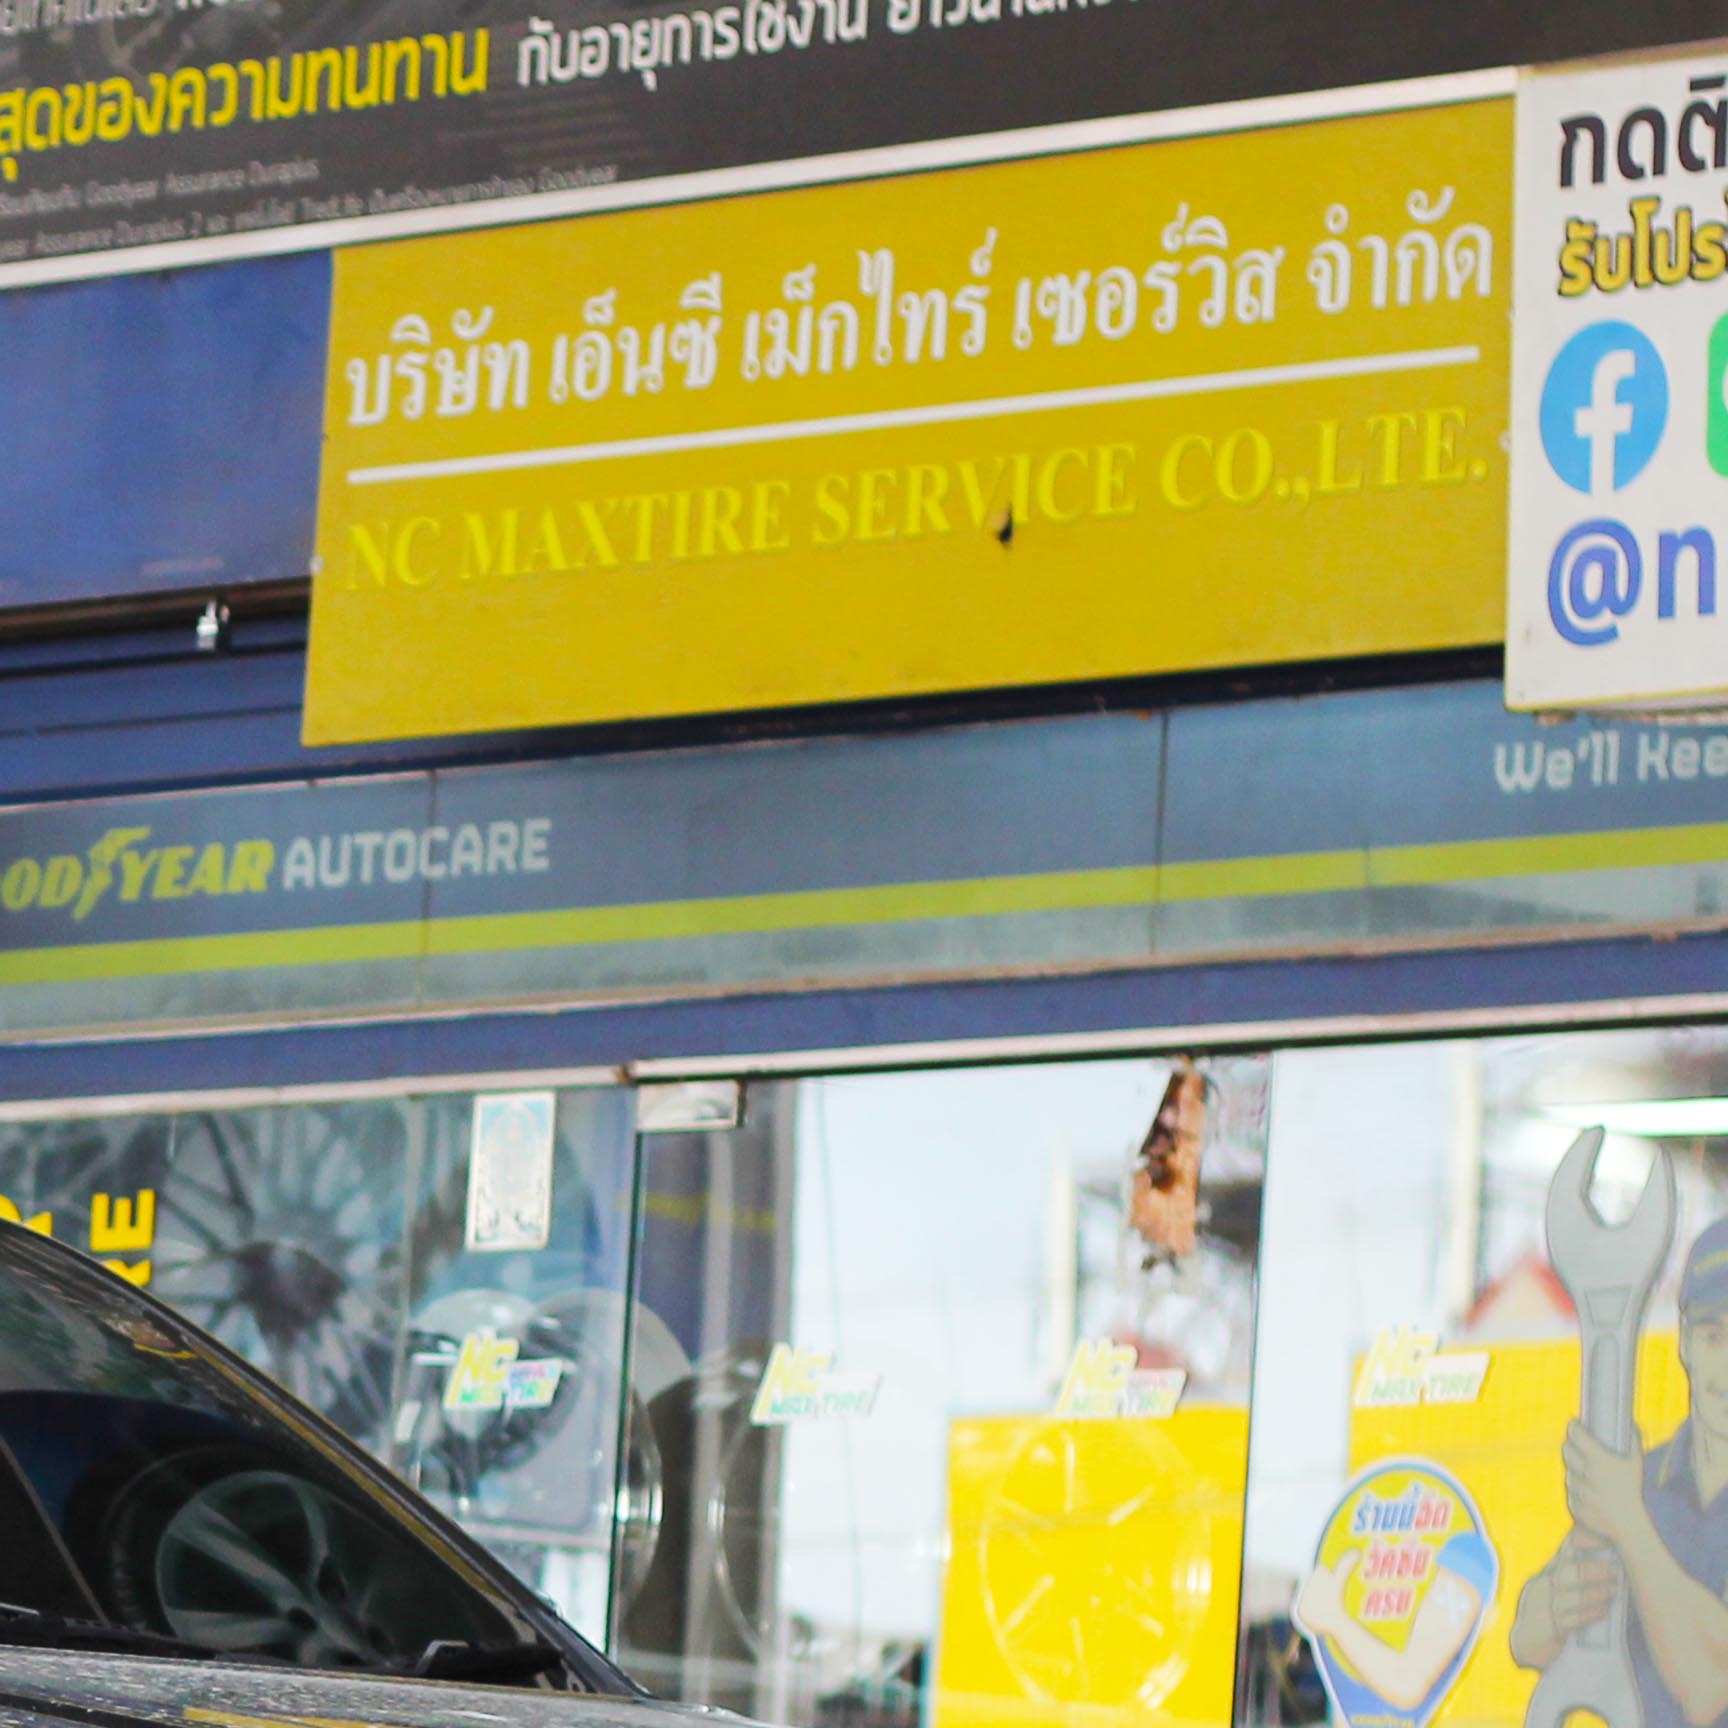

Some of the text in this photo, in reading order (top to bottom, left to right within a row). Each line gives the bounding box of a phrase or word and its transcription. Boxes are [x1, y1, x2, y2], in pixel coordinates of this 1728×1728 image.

[517, 0, 869, 90] กับอายุการใชงาน
[346, 185, 1494, 426] บริษัท เอ็นซี เม็กไทร์ เซอร์วิส จำกัด
[347, 515, 439, 592] NC
[460, 480, 790, 580] MAXTIRE
[812, 441, 1137, 549] SERVICE
[1493, 733, 1620, 795] We'll
[282, 817, 552, 892] AUTOCARE
